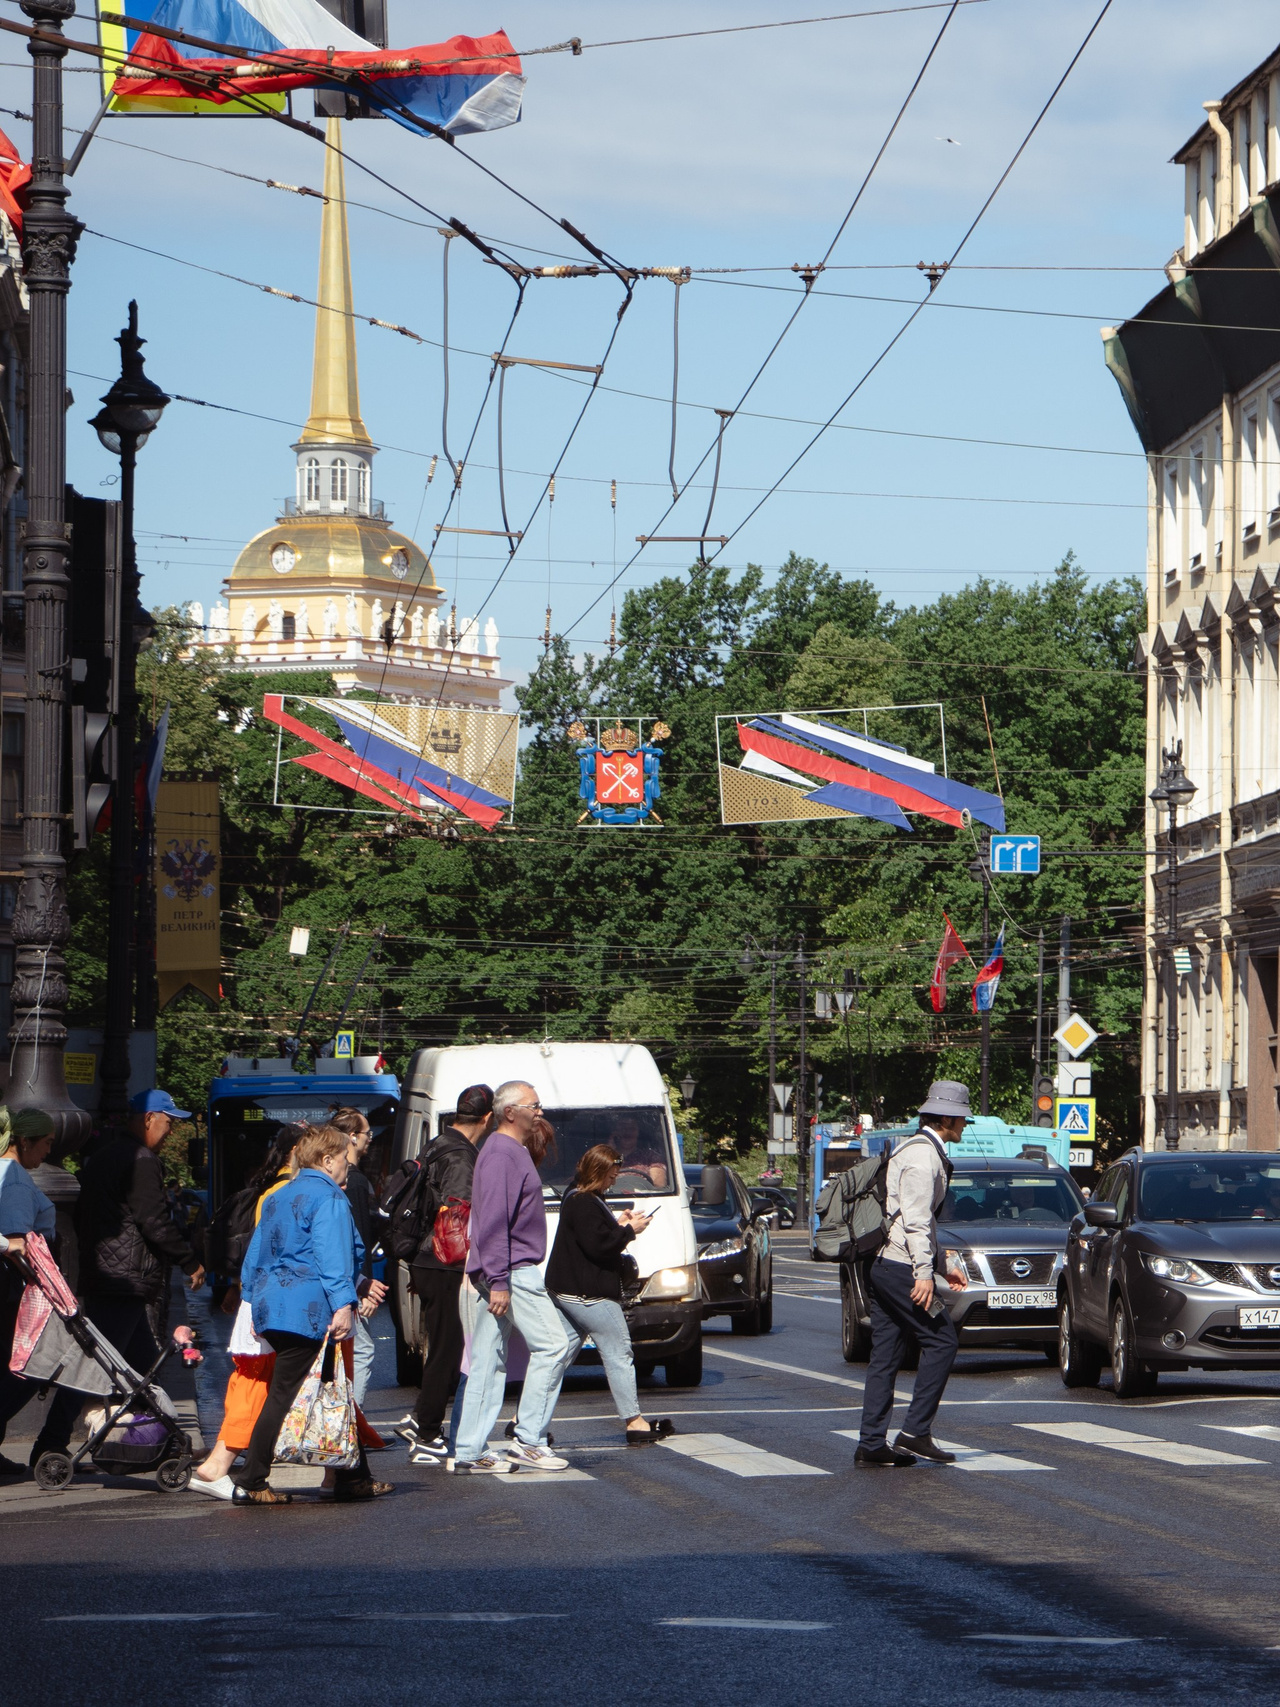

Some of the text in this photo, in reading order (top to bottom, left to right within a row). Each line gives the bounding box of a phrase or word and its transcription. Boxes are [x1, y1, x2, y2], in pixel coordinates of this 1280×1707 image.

[746, 797, 778, 806] 1703
[173, 911, 203, 919] ПЕТР
[160, 920, 216, 932] ВЕЛИКИЙ
[992, 1292, 1054, 1304] М080ЕХ 98
